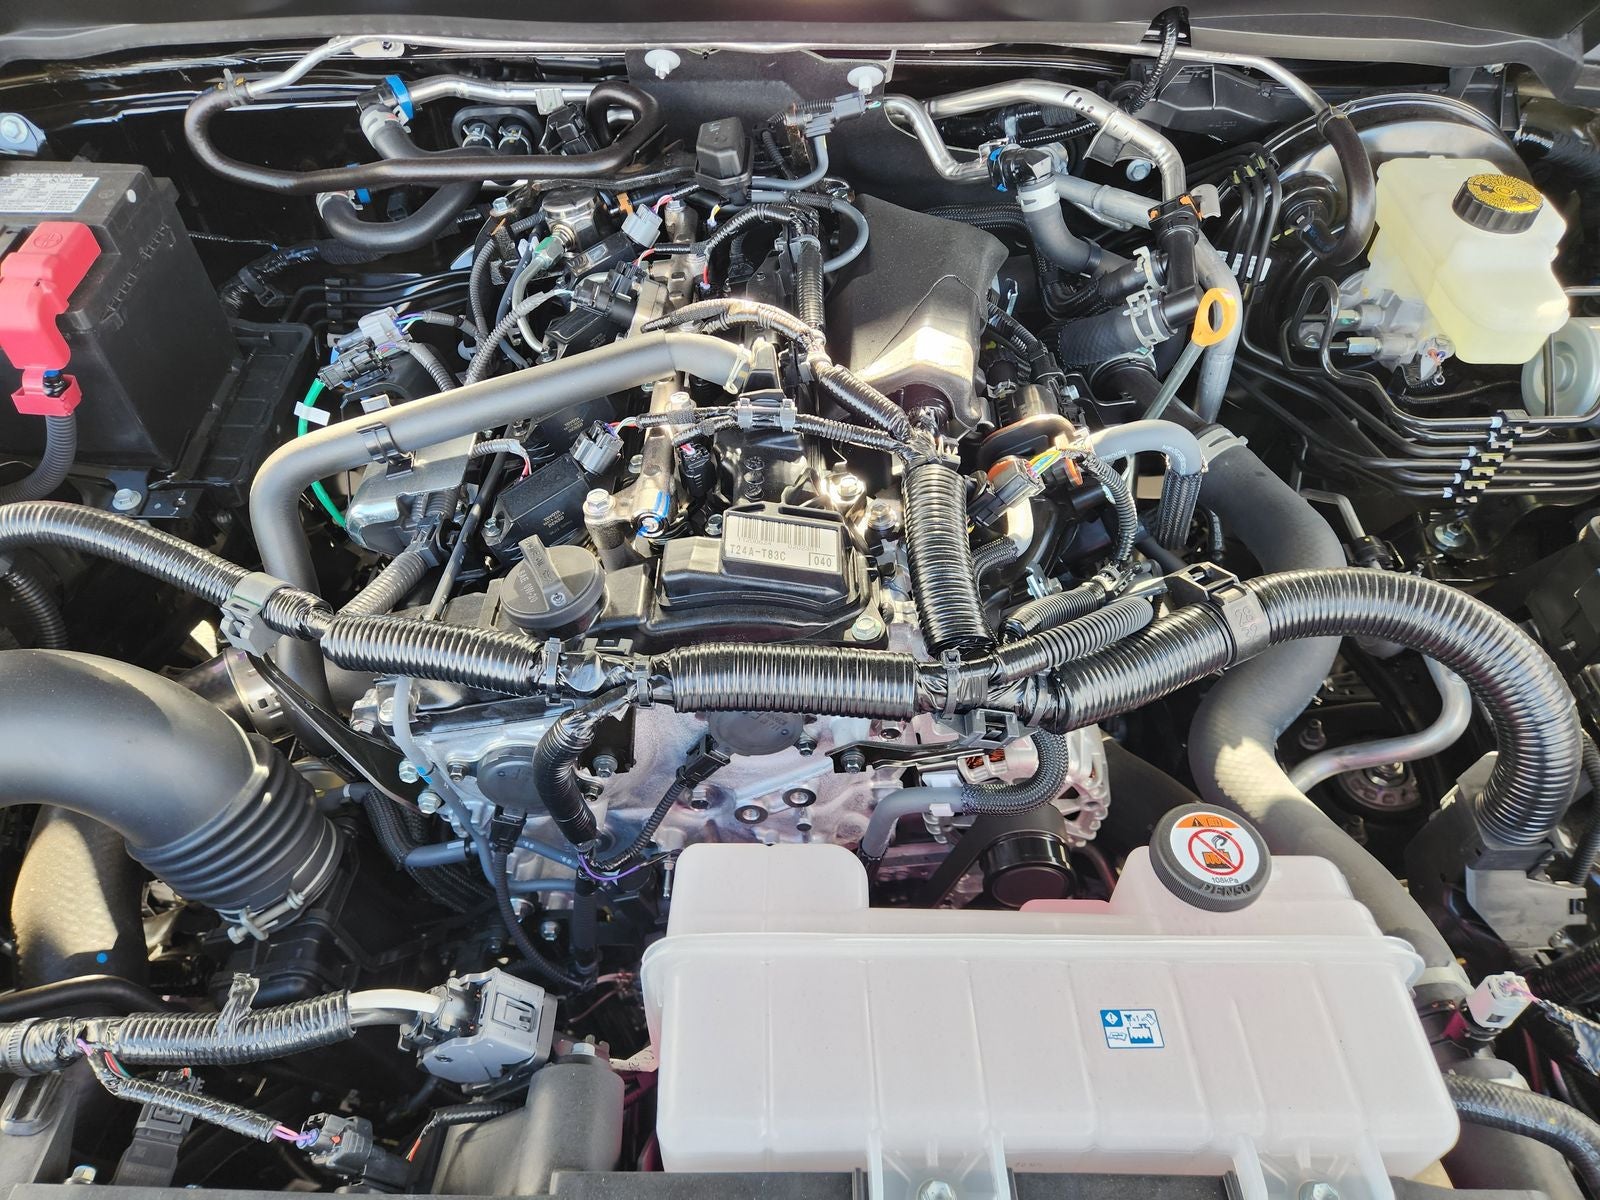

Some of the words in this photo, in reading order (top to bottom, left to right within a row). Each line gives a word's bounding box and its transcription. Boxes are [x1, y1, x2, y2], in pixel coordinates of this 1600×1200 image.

[730, 544, 786, 561] T24A-T83C
[814, 556, 832, 567] 040
[1203, 883, 1252, 897] DENSO
